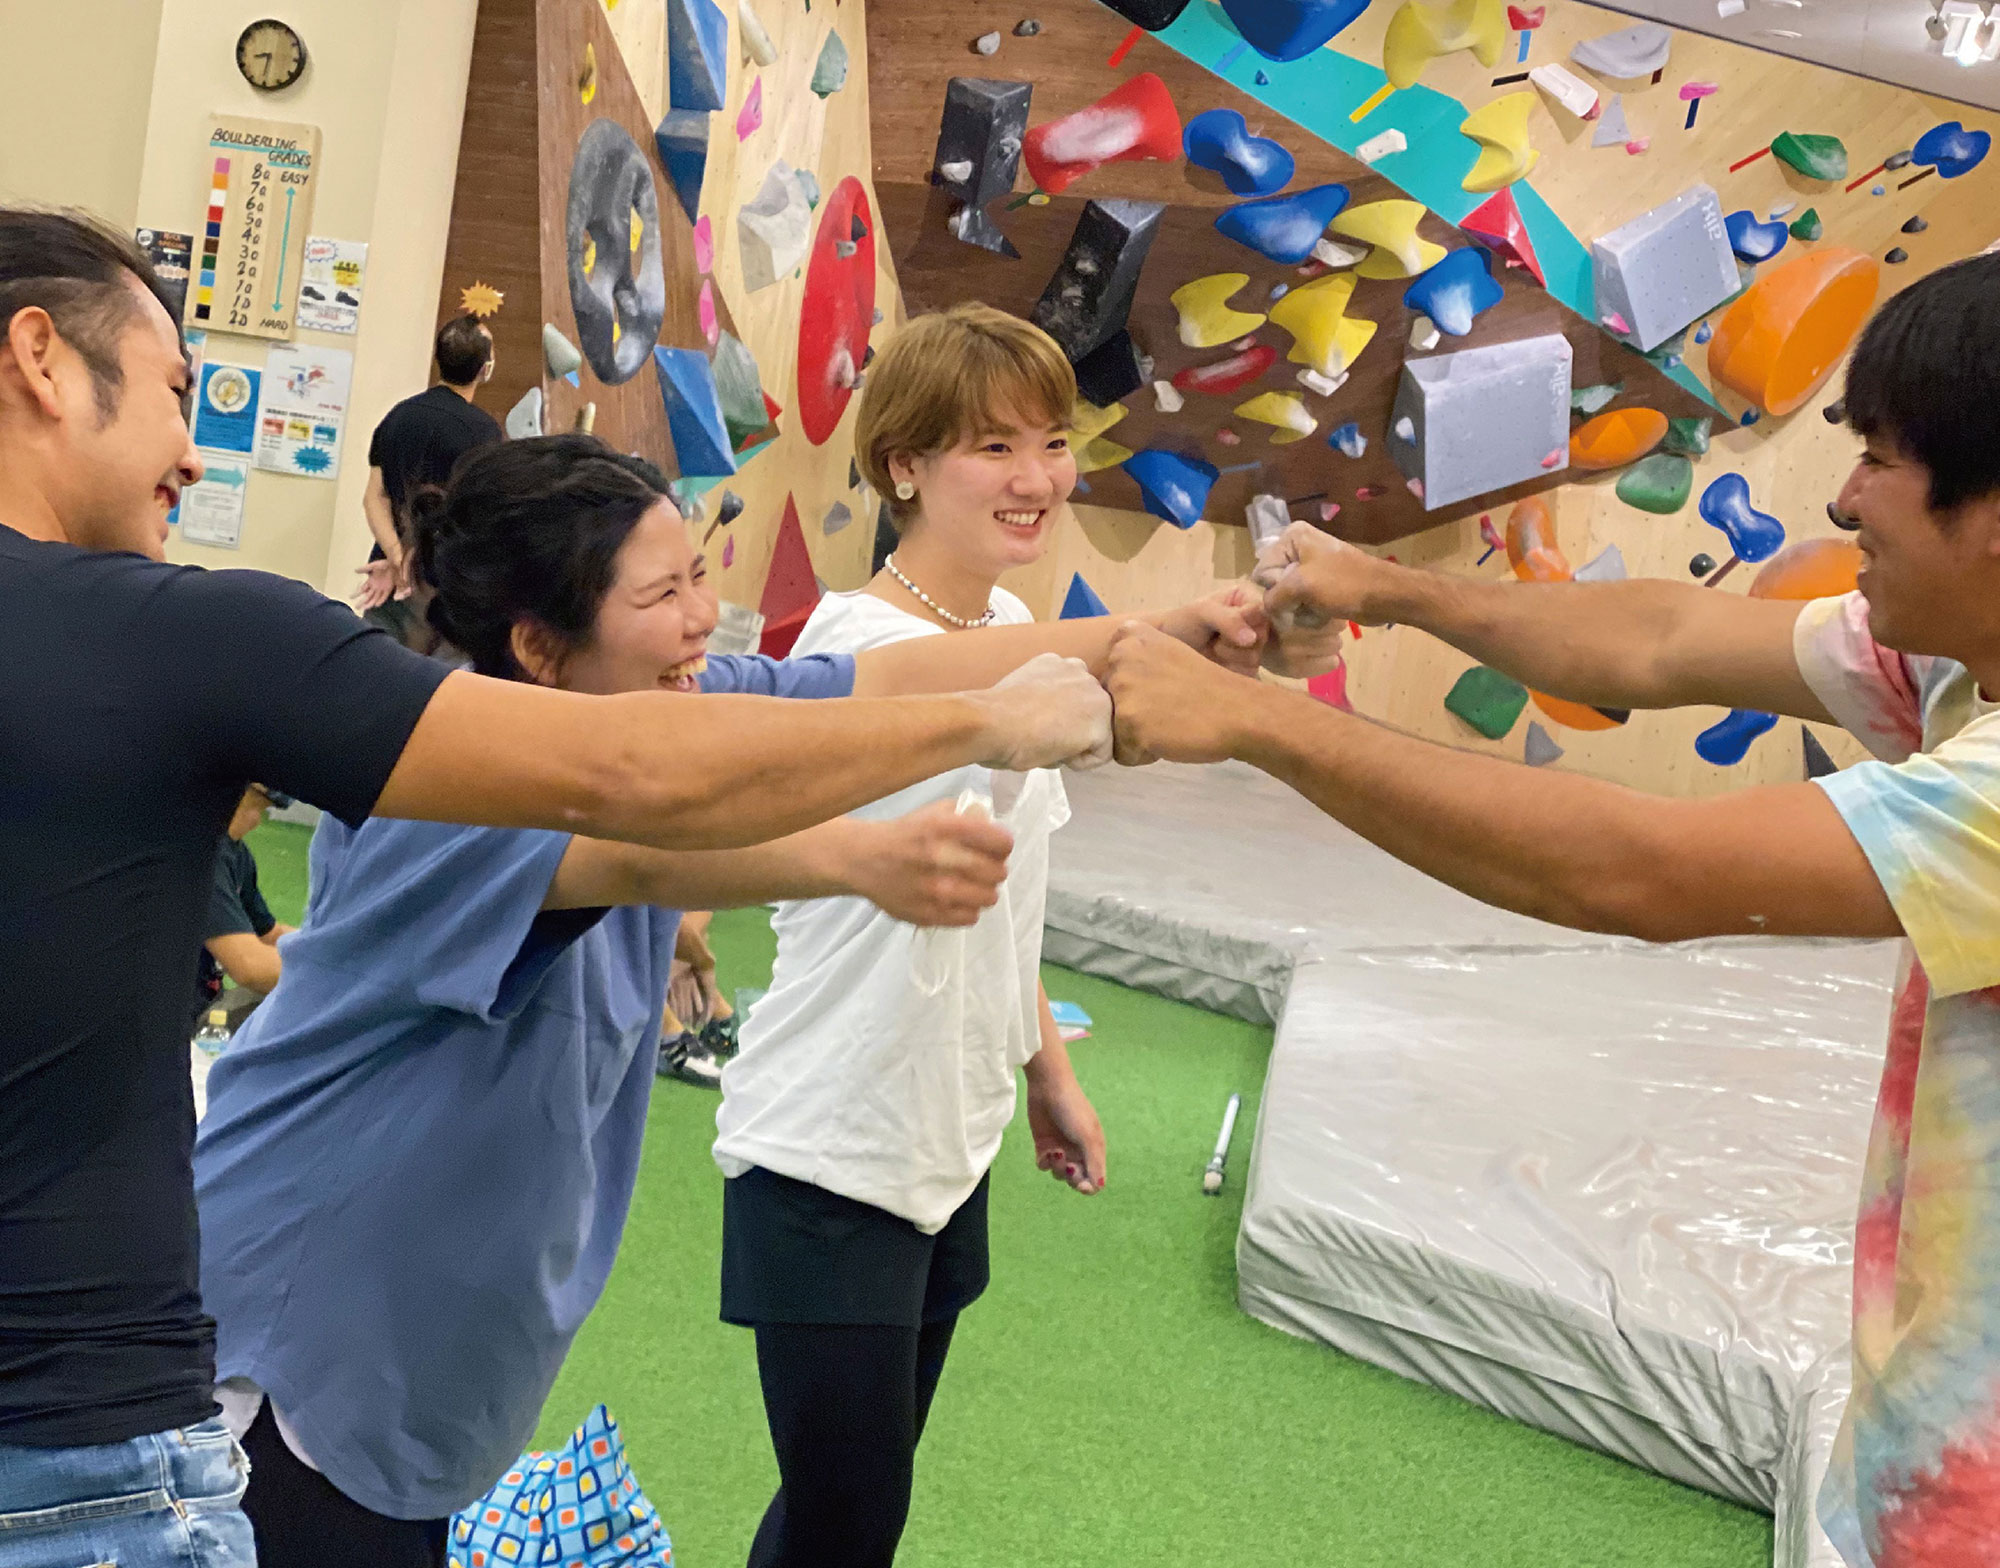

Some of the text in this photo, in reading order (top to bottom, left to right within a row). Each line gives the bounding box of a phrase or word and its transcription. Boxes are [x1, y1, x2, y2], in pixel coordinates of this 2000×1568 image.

[268, 151, 311, 166] GRADES
[281, 171, 309, 185] EASY
[260, 319, 288, 330] HARD
